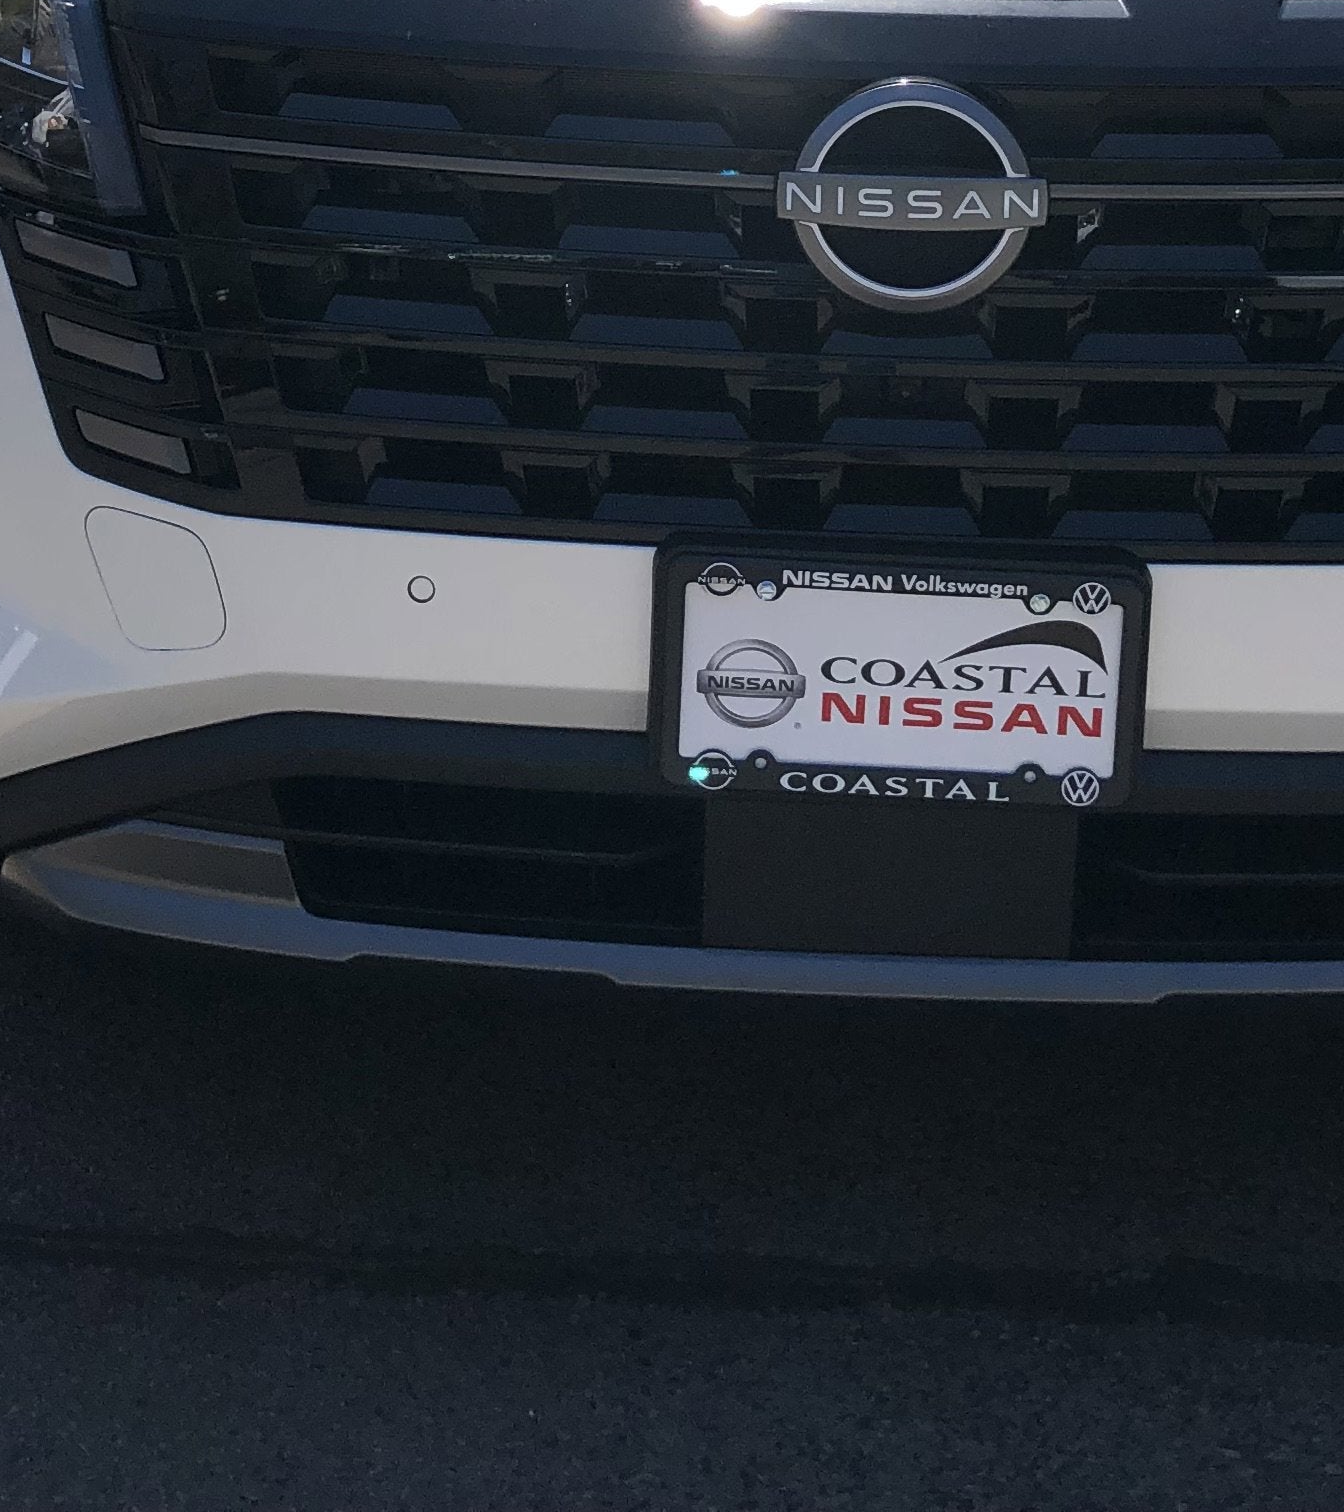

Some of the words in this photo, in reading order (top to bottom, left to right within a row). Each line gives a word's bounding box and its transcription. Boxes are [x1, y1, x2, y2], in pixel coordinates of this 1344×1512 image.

[785, 181, 1040, 219] NISSAN
[697, 576, 746, 585] NISSAN
[782, 569, 894, 591] NISSAN
[901, 574, 1029, 598] Volkswagen
[707, 674, 796, 694] NISSAN
[820, 656, 1108, 699] COASTAL
[820, 692, 1104, 738] NISSAN
[779, 771, 1011, 803] COASTAL
